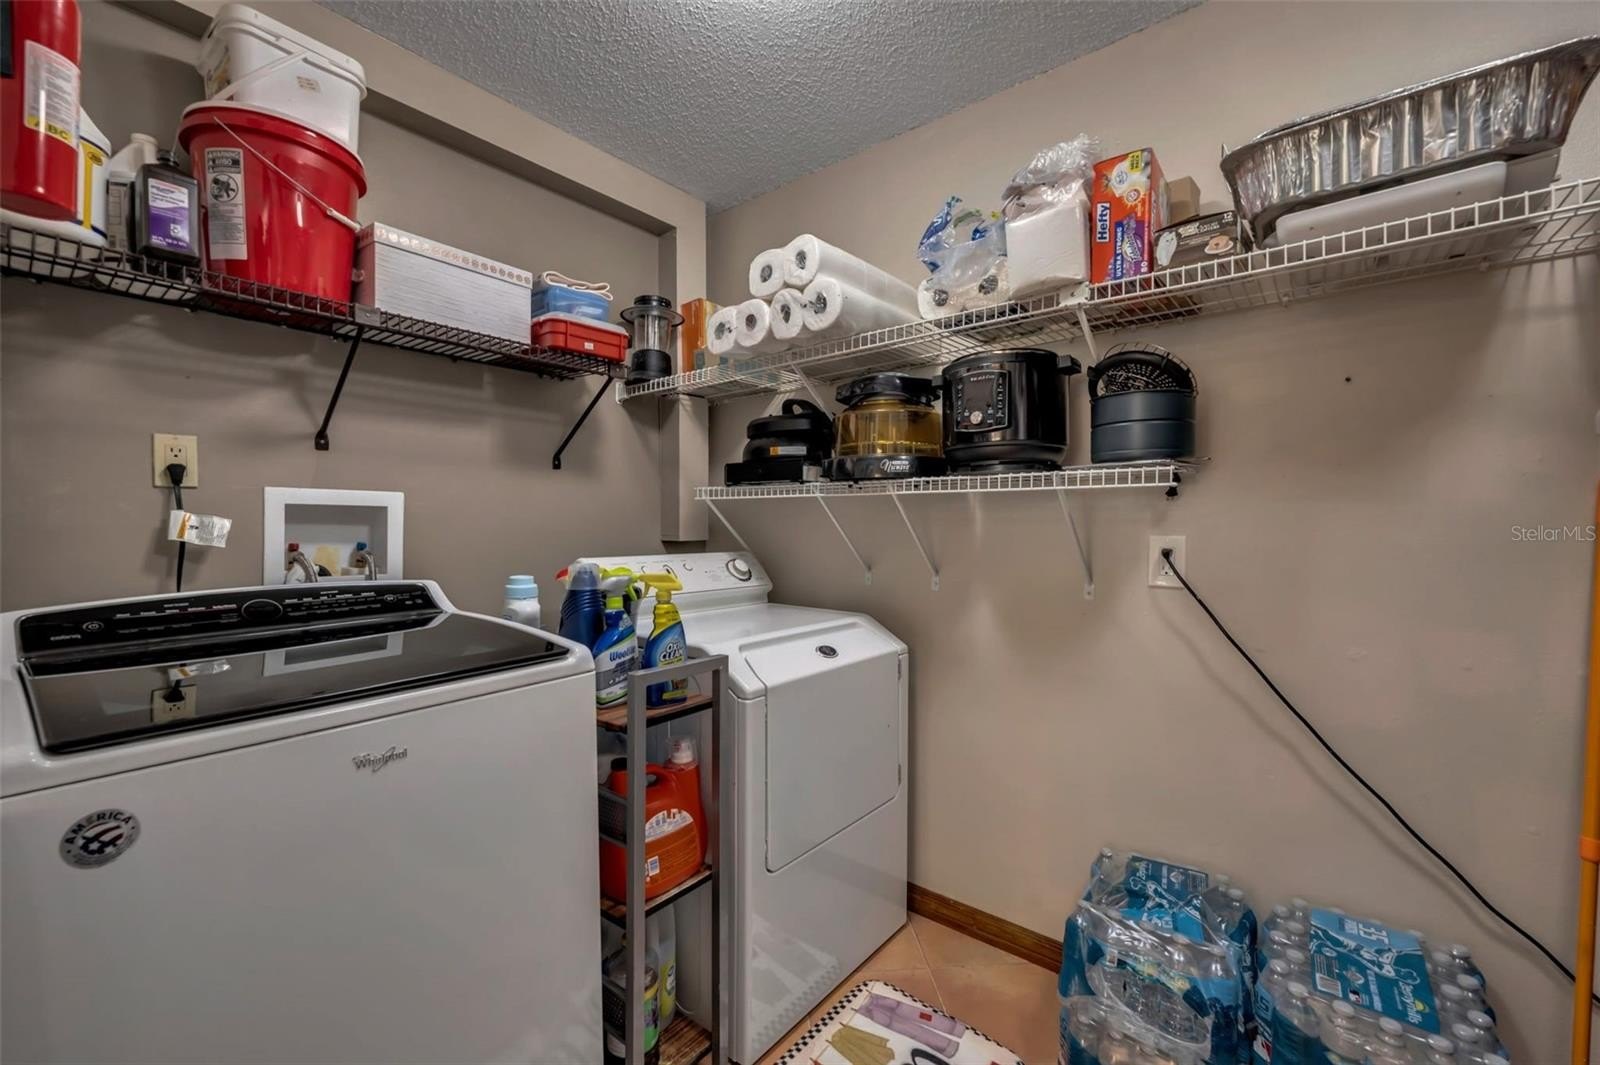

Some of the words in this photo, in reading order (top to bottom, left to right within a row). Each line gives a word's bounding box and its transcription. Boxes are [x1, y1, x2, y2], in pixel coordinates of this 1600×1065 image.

[1097, 204, 1109, 241] Hefty
[1223, 211, 1233, 219] 12
[1115, 226, 1123, 254] STRONG
[352, 746, 408, 773] Whirlpool
